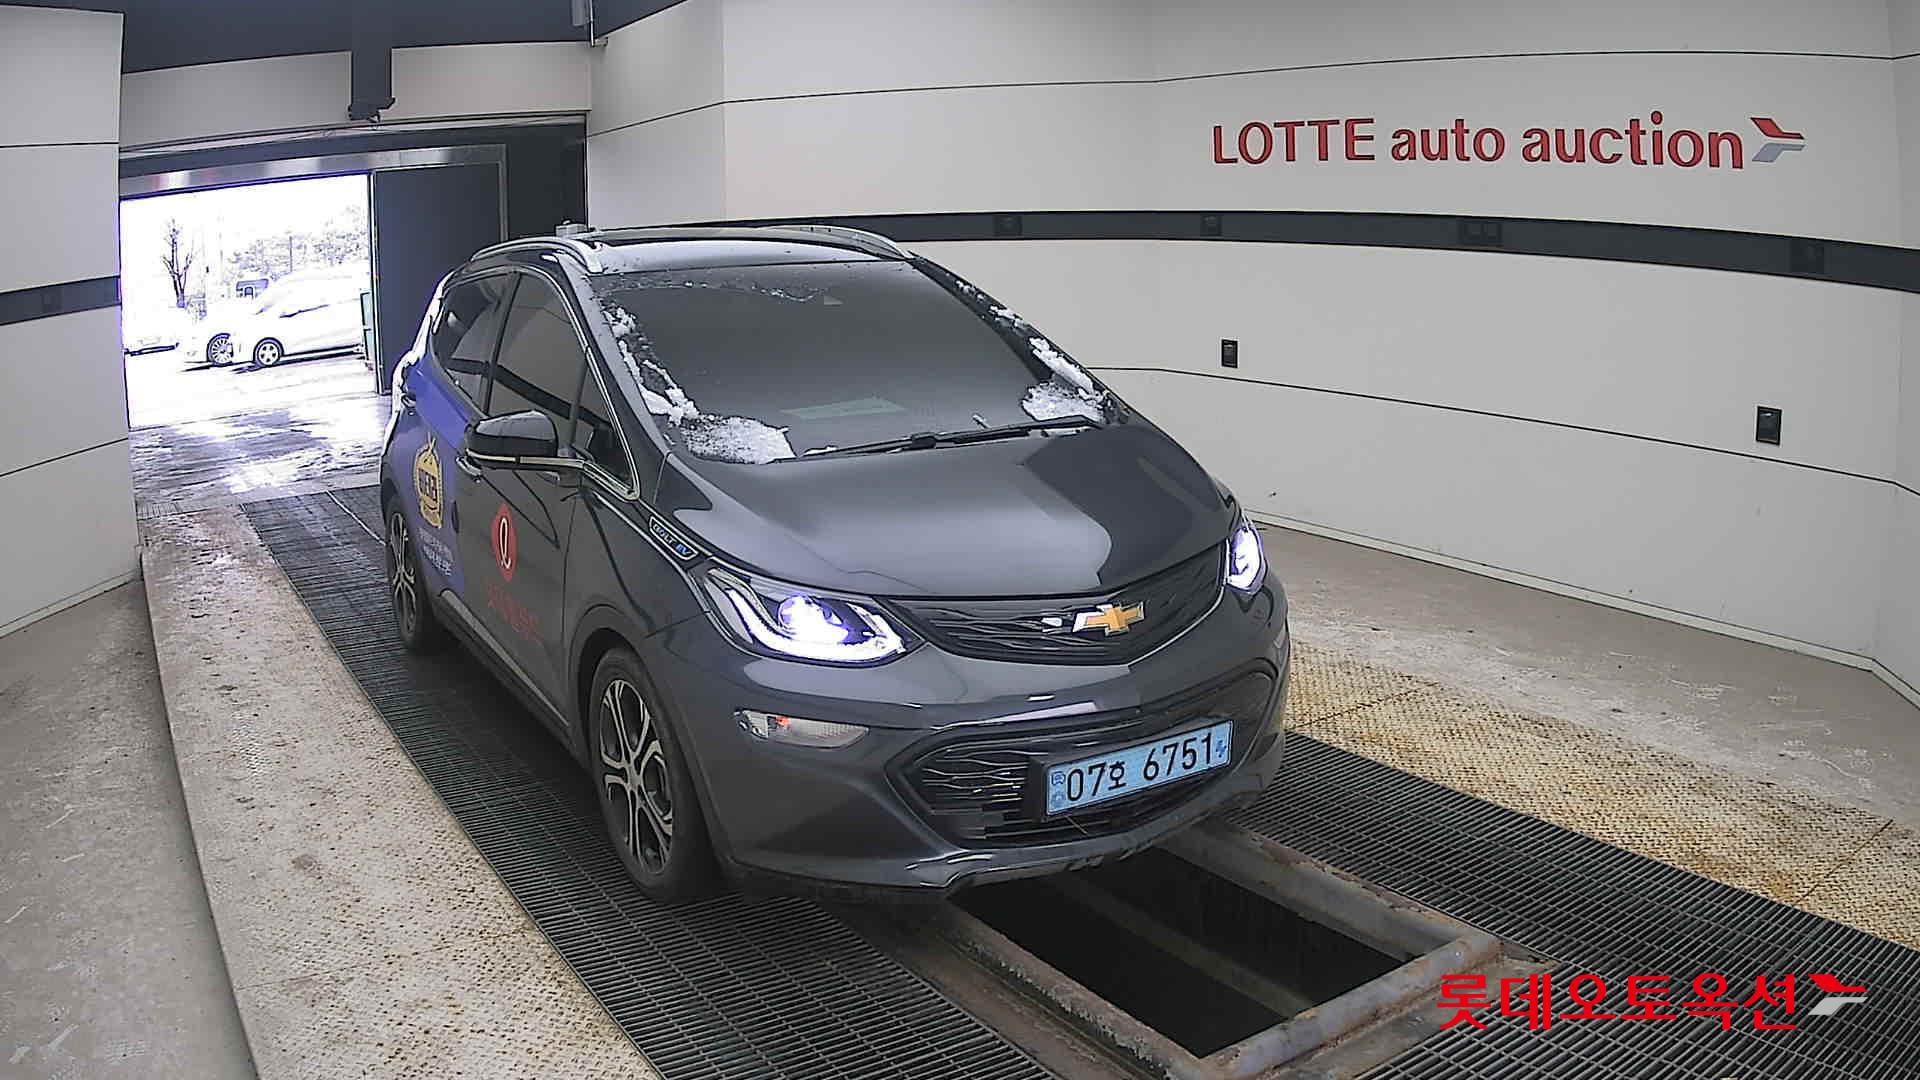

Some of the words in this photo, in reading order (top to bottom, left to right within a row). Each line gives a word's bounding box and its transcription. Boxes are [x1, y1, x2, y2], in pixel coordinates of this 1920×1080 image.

[1212, 118, 1376, 165] LOTTE
[1391, 119, 1506, 162] auto
[1521, 111, 1745, 170] auction
[1066, 760, 1127, 802] 07호
[1142, 732, 1213, 782] 6751
